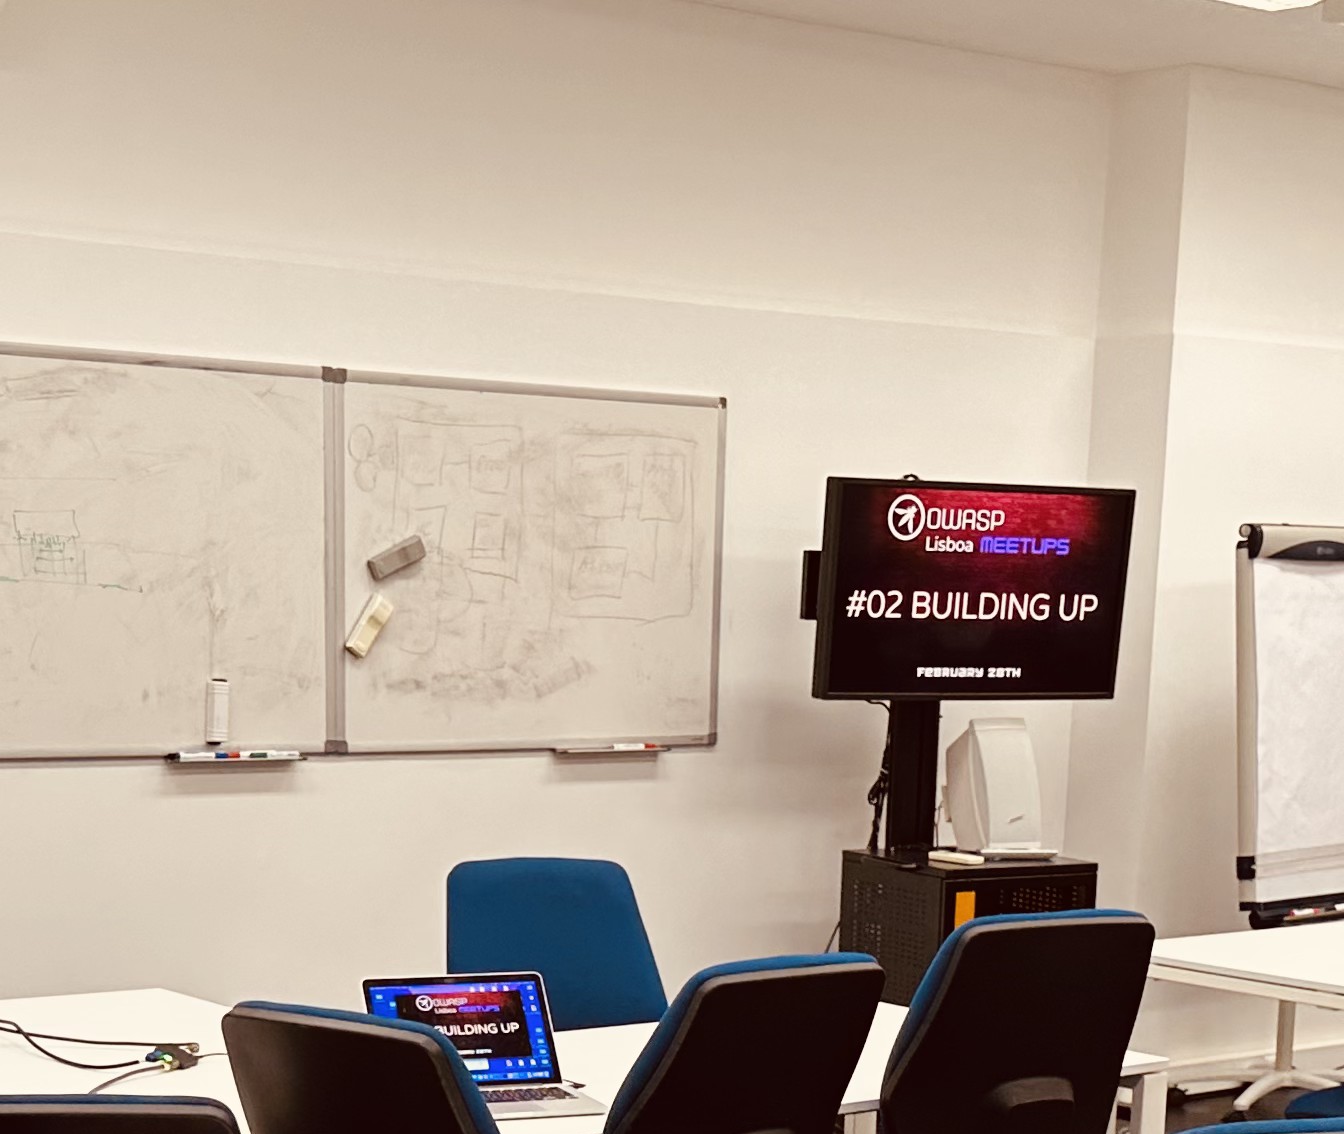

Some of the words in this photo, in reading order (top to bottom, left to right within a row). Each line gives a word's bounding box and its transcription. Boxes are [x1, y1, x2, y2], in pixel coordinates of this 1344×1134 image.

[927, 507, 1006, 532] OWASP
[925, 535, 974, 554] Lisboa
[979, 535, 1070, 556] MEETUPS
[845, 589, 903, 620] #02
[911, 590, 1051, 621] BUILDING
[1058, 593, 1099, 622] UP
[987, 666, 1022, 679] 28TH
[500, 1022, 520, 1034] UP
